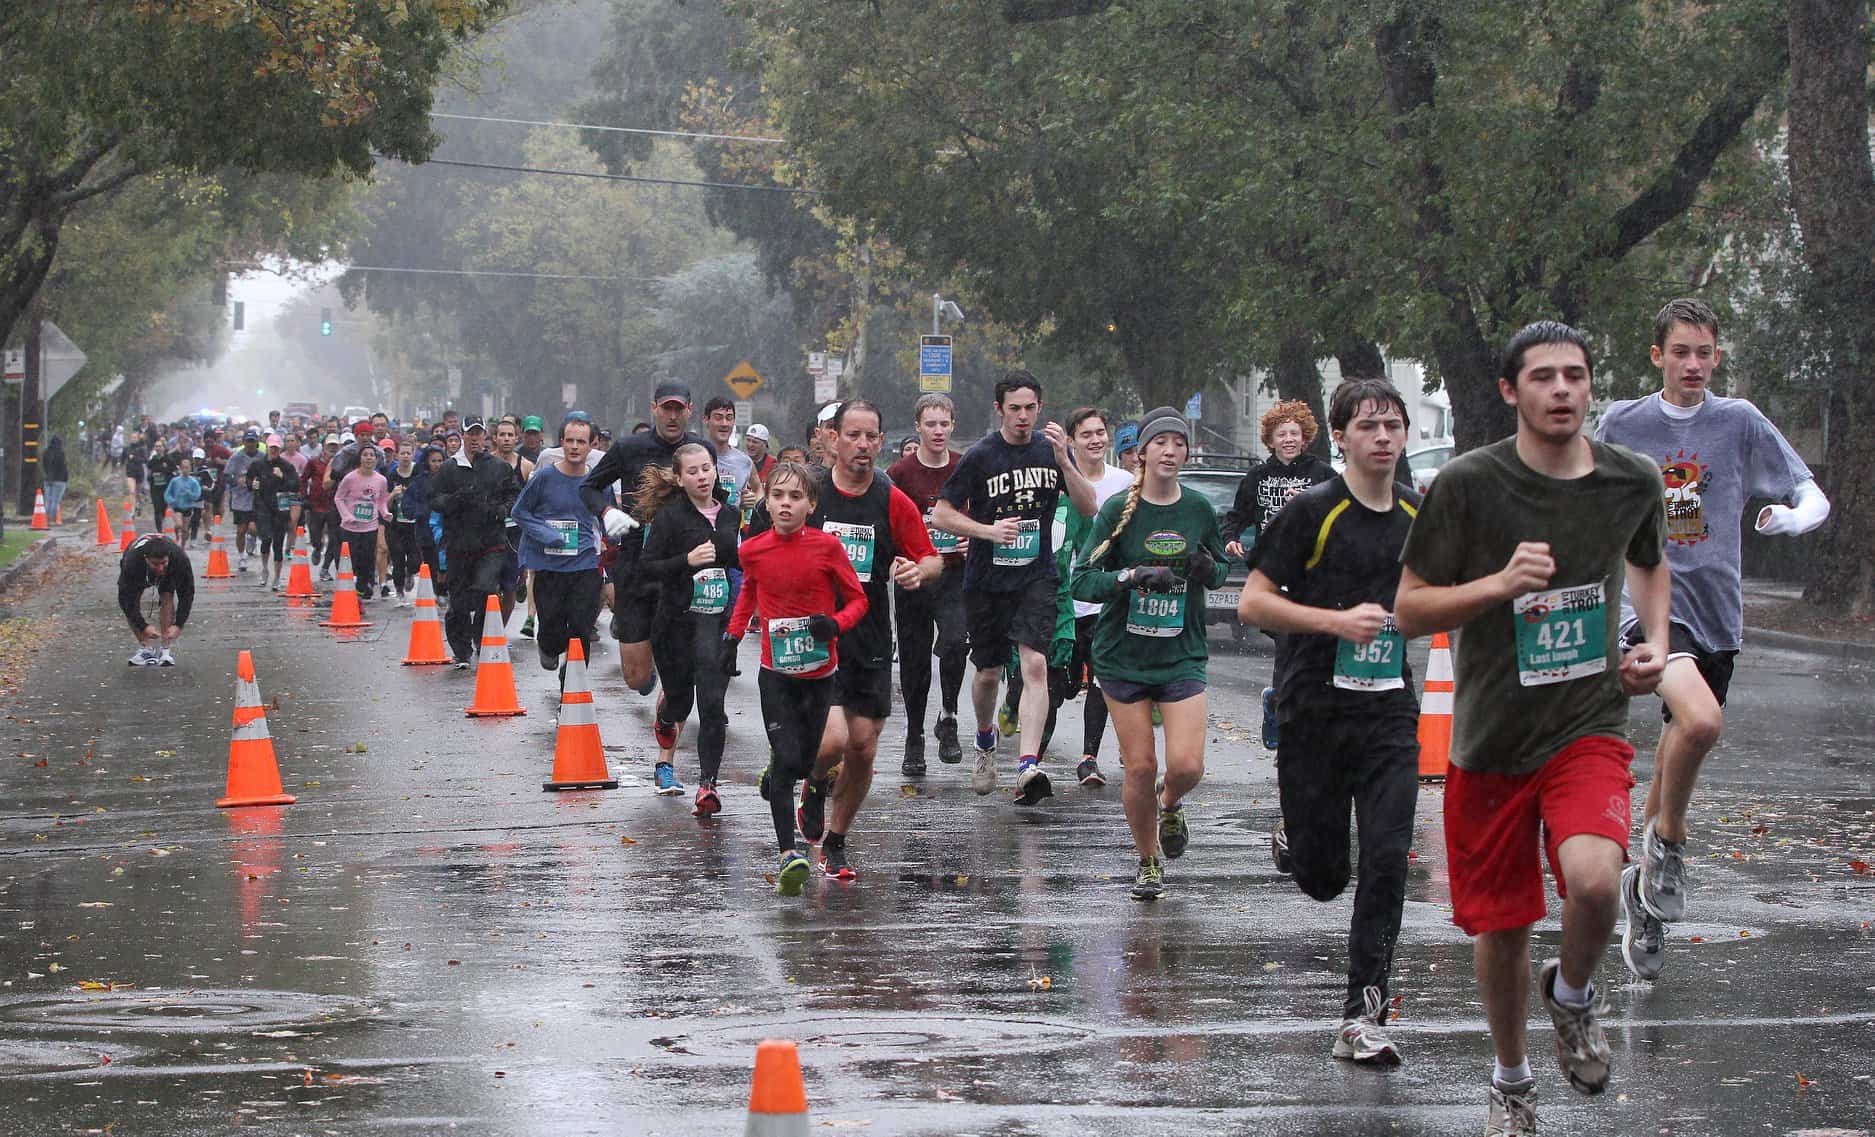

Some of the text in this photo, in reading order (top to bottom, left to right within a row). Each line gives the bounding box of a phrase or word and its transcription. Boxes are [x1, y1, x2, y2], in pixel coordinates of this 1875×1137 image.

[986, 467, 1058, 498] UC DAVIS
[843, 543, 867, 561] 99
[703, 584, 723, 598] 485
[1137, 598, 1179, 617] 1804
[1570, 597, 1600, 613] TROT
[1537, 618, 1586, 650] 421
[1353, 640, 1393, 663] 952
